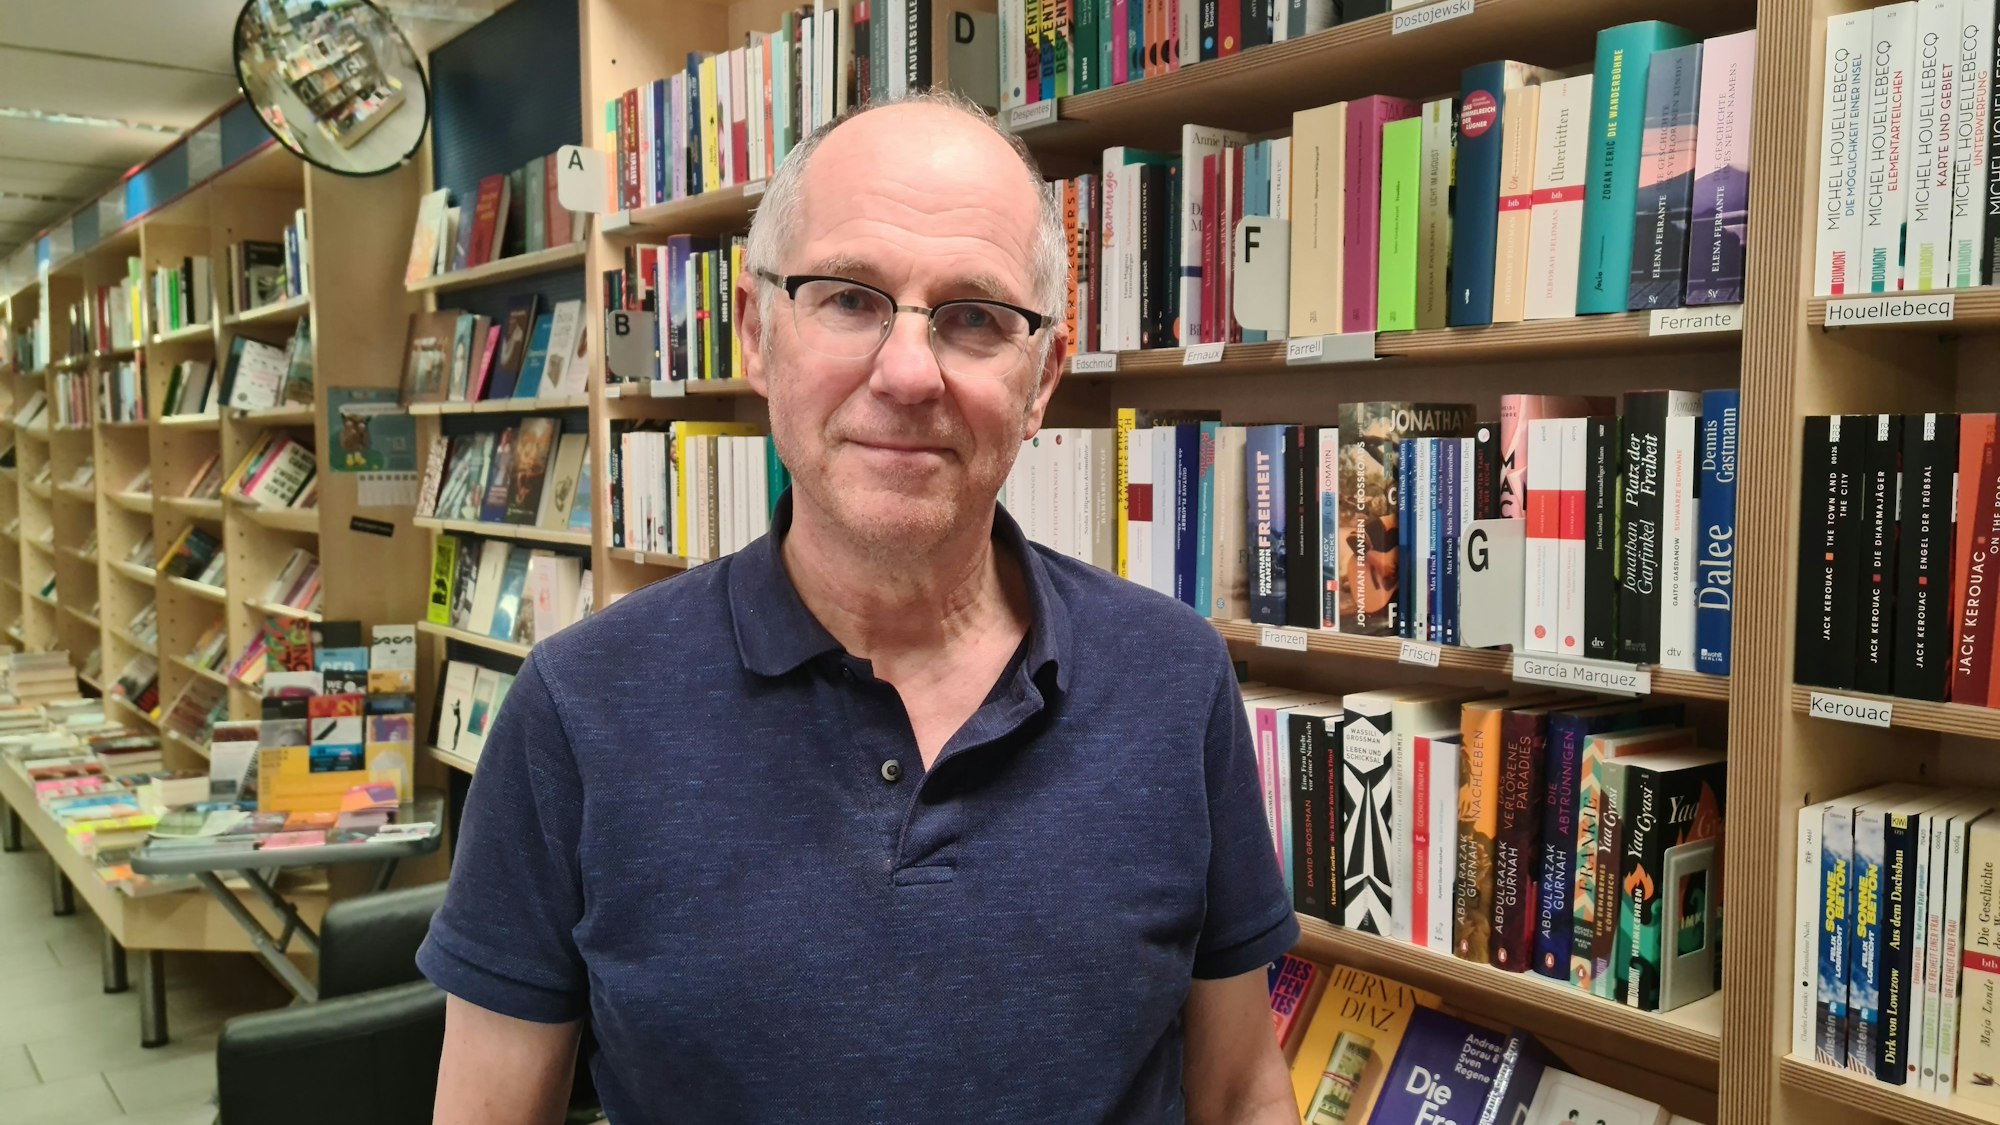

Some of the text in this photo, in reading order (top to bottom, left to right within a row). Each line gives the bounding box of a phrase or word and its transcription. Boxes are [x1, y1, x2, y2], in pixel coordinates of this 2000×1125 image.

[955, 11, 974, 44] D
[1013, 104, 1049, 121] Despentes
[1828, 48, 1849, 230] MICHEL HOUELLEBECQ
[1845, 53, 1862, 216] DIE MÖGLICHKEIT EINER INSEL
[1869, 40, 1892, 227] MICHEL HOUELLEBECQ
[1887, 70, 1903, 191] ELEMENTARTEILCHEN
[1914, 32, 1939, 222] MICHEL HOUELLEBECQ
[1937, 63, 1953, 187] KARTE UND GEBIET
[1955, 24, 1979, 217] MICHEL HOUELLEBECQ
[1973, 70, 1988, 167] UNTERWERFUNG
[568, 150, 583, 171] A
[1548, 108, 1568, 181] Überbitten
[1552, 191, 1562, 199] btb
[1246, 226, 1261, 263] F
[1653, 195, 1667, 278] ELENA FERRANTE
[1712, 185, 1725, 272] ELENA FERRANTE
[1832, 250, 1846, 282] DUMONT
[1872, 247, 1887, 281] DUMONT
[614, 314, 630, 335] B
[1660, 313, 1731, 329] Ferrante
[1829, 300, 1950, 321] Houellebecq
[1076, 358, 1112, 370] Edschmid
[1187, 350, 1220, 362] Ernaux
[1289, 341, 1321, 355] Farrell
[1200, 432, 1209, 479] Royale
[1206, 439, 1216, 466] Villa
[1626, 433, 1641, 507] Platz der
[1640, 433, 1658, 496] Freiheit
[1702, 420, 1718, 471] Dennis
[1716, 407, 1737, 483] Gastmann
[1257, 451, 1272, 547] FREIHEIT
[1357, 441, 1366, 511] CROSSROADS
[1829, 472, 1837, 493] AND
[1828, 497, 1836, 524] TOWN
[1874, 471, 1885, 567] DIE DHARMAJÄGER
[1920, 465, 1932, 569] ENGEL DER TRÜBSAL
[1258, 549, 1267, 596] JONATHAN
[1357, 519, 1366, 627] JONATHAN FRANZEN
[1468, 528, 1489, 572] G
[1624, 521, 1637, 593] Jonathan
[1638, 519, 1658, 595] Garfinkel
[1699, 524, 1733, 611] Dalee
[1823, 566, 1833, 640] JACK KEROUAC
[1870, 588, 1881, 663] JACK KEROUAC
[1916, 591, 1927, 668] JACK KEROUAC
[1959, 551, 1986, 675] JACK KEROUAC
[1265, 631, 1305, 645] Franzen
[1402, 644, 1437, 662] Frisch
[1592, 637, 1604, 648] dtv
[1667, 648, 1681, 656] dtv
[1524, 661, 1636, 688] García Marquez
[1351, 727, 1377, 737] WASSILI
[1811, 696, 1890, 722] Kerouac
[1346, 734, 1381, 745] GROSSMAN
[1346, 746, 1382, 756] LEBEN UND
[1346, 752, 1381, 764] SCHICKSAL
[1472, 730, 1484, 819] NACHLEBEN
[1504, 741, 1518, 829] VERLORENE
[1516, 736, 1531, 809] PARADIES
[1548, 783, 1557, 805] DIE
[1599, 785, 1623, 854] Yaa Gyasi
[1628, 784, 1657, 859] Yaa Gyasi
[1668, 796, 1700, 825] Yaa
[1306, 799, 1314, 887] DAVID GROSSMAN
[1467, 841, 1478, 897] GURNAH
[1457, 834, 1468, 925] ABDULRAZAK
[1495, 840, 1507, 934] ABDULRAZAK
[1506, 847, 1518, 906] GURNAH
[1541, 843, 1555, 939] ABDULRAZAK
[1554, 850, 1567, 910] GURNAH
[1598, 864, 1607, 917] ERHABENES
[1826, 871, 1837, 932] SONNE
[1834, 859, 1846, 920] BETON
[1866, 864, 1879, 925] BETON
[1889, 850, 1904, 950] Aus dem Dachsbau
[1978, 861, 1993, 947] Die Geschichte
[1632, 888, 1643, 957] HEIMKEHREN
[1857, 876, 1869, 938] SONNE
[1277, 975, 1305, 998] PEN
[1285, 957, 1312, 980] DES
[1867, 930, 1875, 984] LOBRECHT
[1982, 958, 1998, 969] btb
[1271, 992, 1296, 1016] TES
[1886, 968, 1899, 1015] Lowtzow
[1980, 979, 1994, 1047] Maja Lunde
[1458, 1053, 1482, 1069] Sven
[1884, 1039, 1896, 1064] Dirk
[1405, 1065, 1452, 1106] Die
